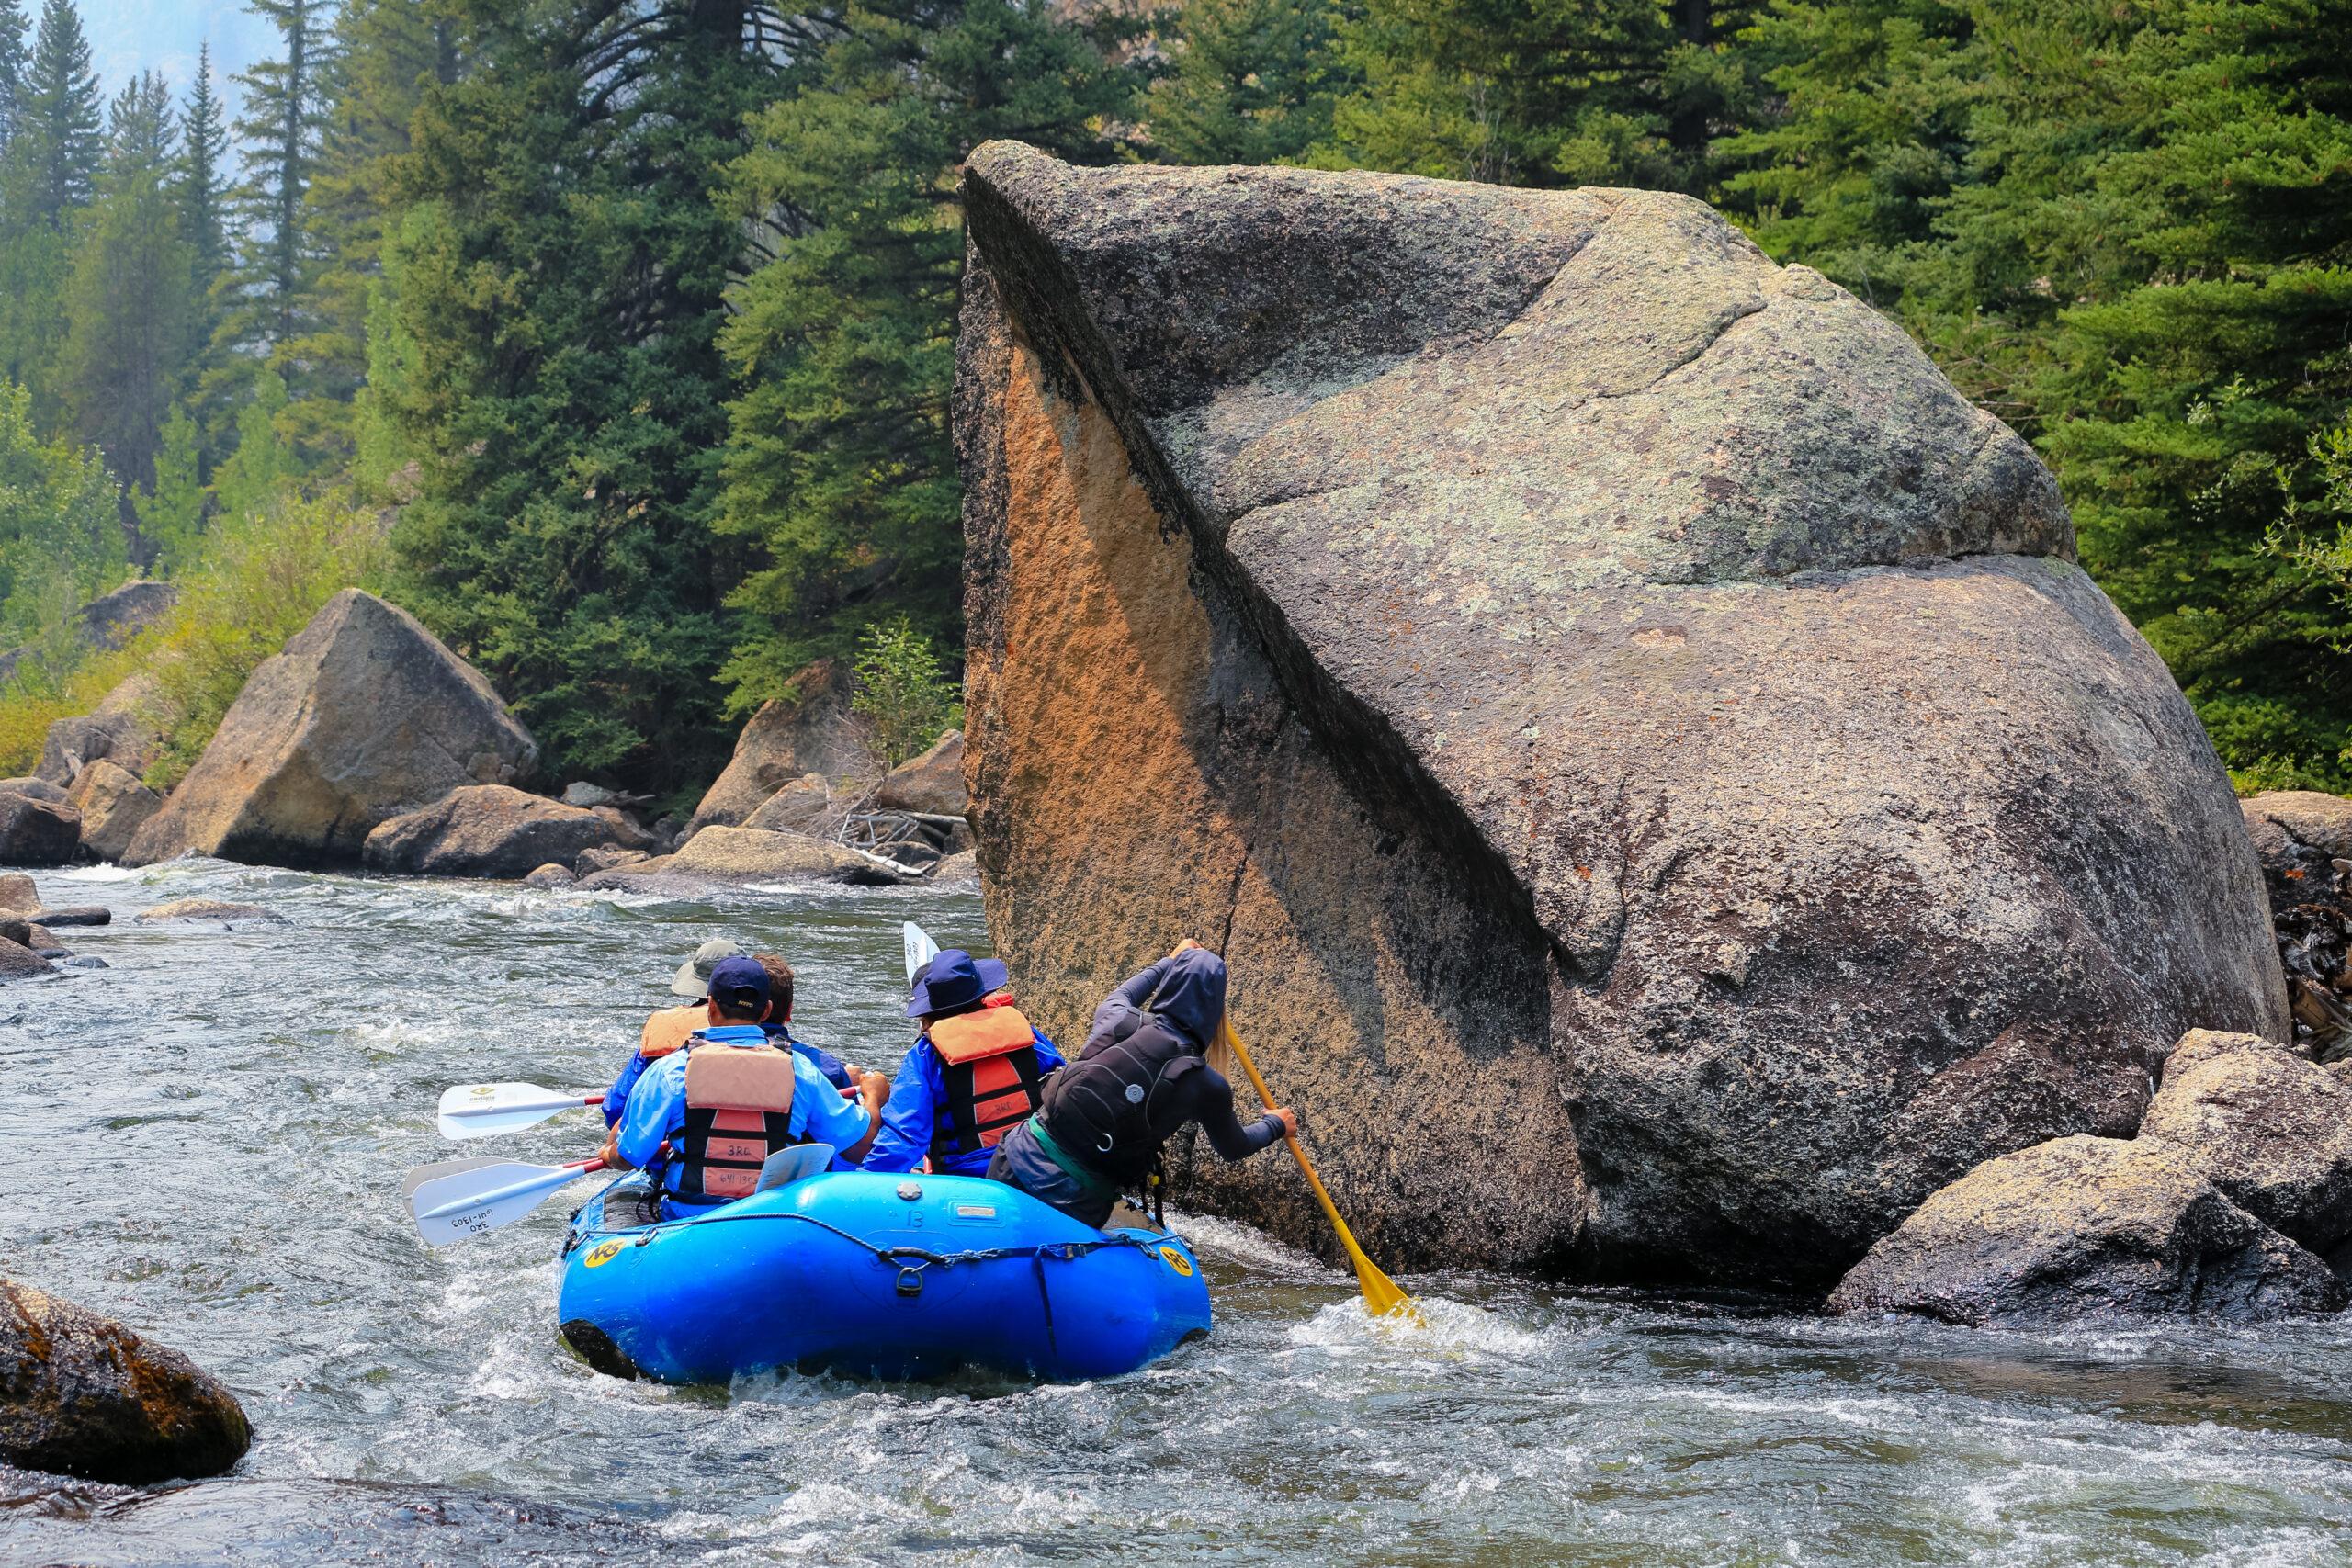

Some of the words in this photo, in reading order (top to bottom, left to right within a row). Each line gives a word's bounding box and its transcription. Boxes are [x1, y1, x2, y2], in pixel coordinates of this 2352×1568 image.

[451, 1208, 493, 1228] 641-1303
[469, 1220, 490, 1233] 3RO
[585, 1240, 626, 1263] NRS
[1161, 1250, 1192, 1270] NRS
